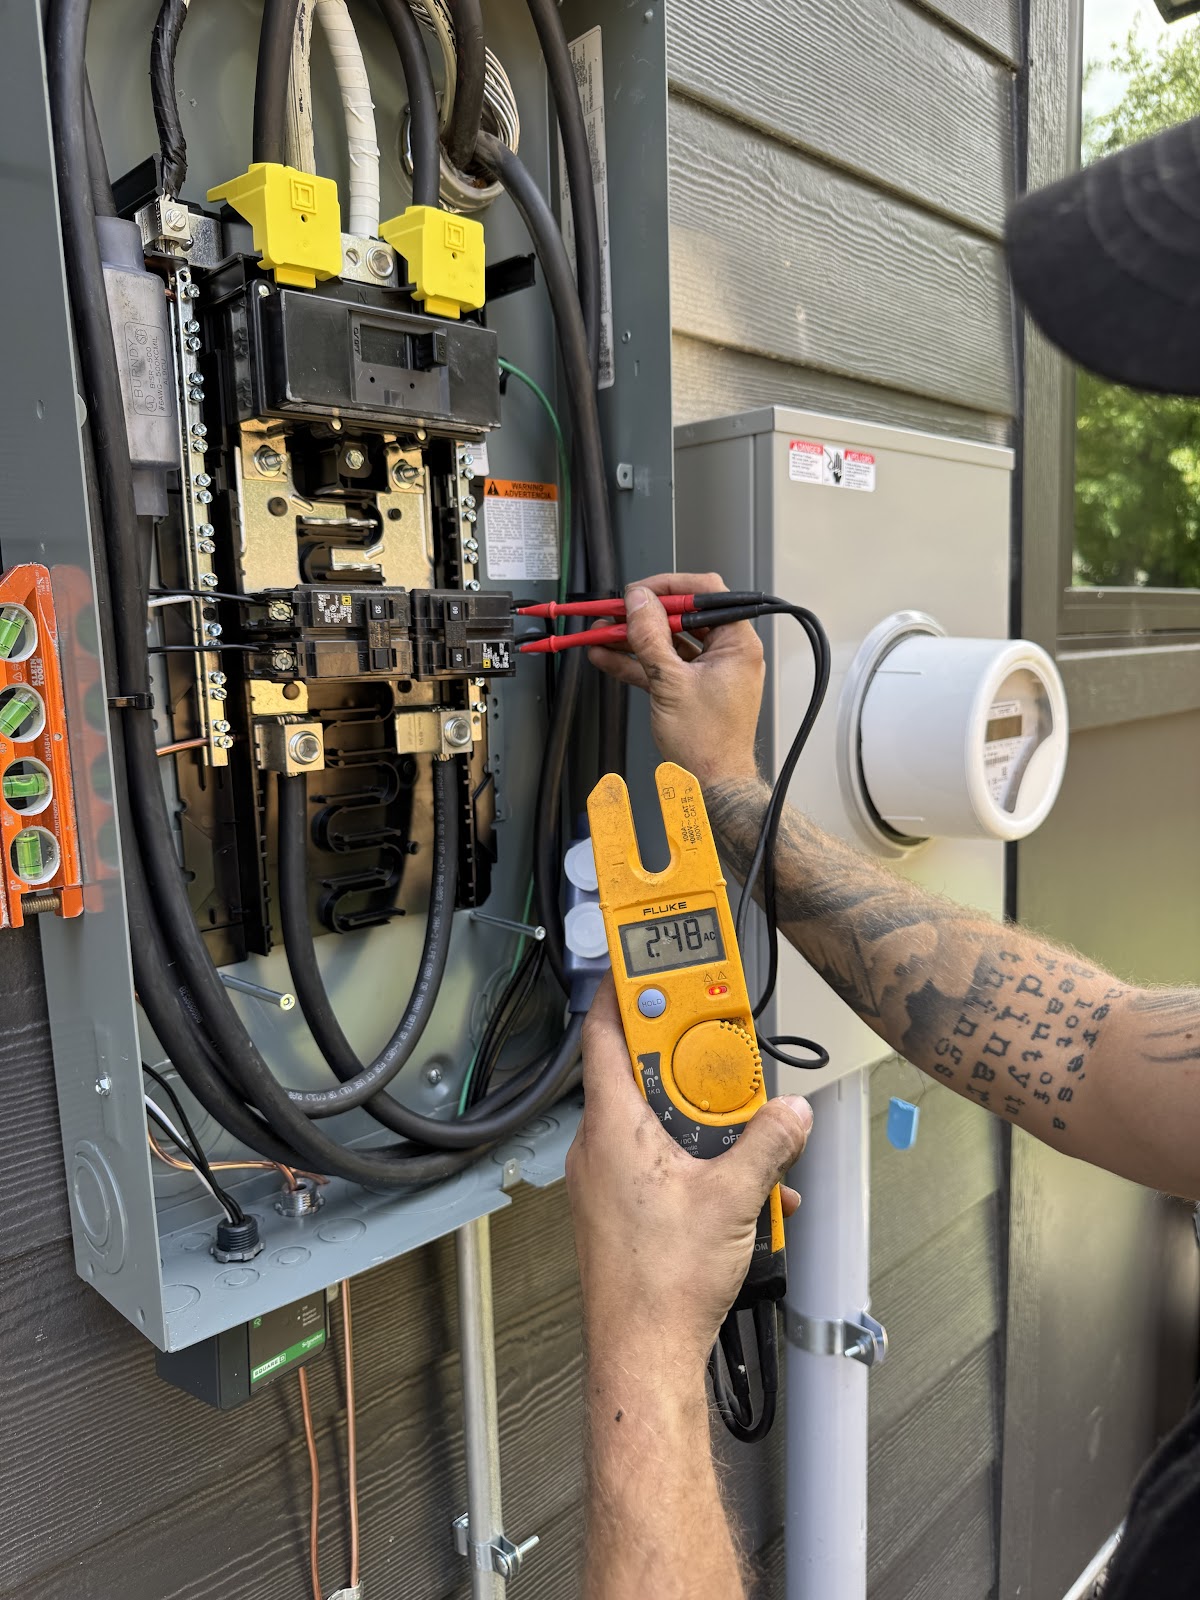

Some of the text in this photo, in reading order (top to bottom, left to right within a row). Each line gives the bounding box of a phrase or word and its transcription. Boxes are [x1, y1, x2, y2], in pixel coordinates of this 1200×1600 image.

[128, 338, 143, 398] BURNDY
[511, 482, 544, 491] WARNING
[504, 490, 552, 499] ADVERTENCIA
[375, 605, 382, 614] 20
[452, 606, 459, 615] 60
[30, 658, 39, 687] KLEIN
[37, 657, 45, 686] TOOLS
[642, 901, 687, 916] FLUKE
[703, 931, 716, 942] AC
[641, 998, 663, 1009] HOLD
[933, 949, 1023, 1079] things
[965, 953, 1059, 1106] rdinar
[1033, 997, 1094, 1105] lot of
[1052, 986, 1126, 1131] here's a
[373, 1060, 386, 1074] FOR
[365, 1071, 375, 1081] CT
[353, 1078, 366, 1088] USE
[327, 1090, 338, 1099] OR
[339, 1085, 353, 1095] (UL)
[1003, 1094, 1026, 1116] in
[664, 1110, 672, 1121] A
[691, 1132, 699, 1143] V
[754, 1241, 769, 1252] OM
[254, 1360, 279, 1377] SQUARE
